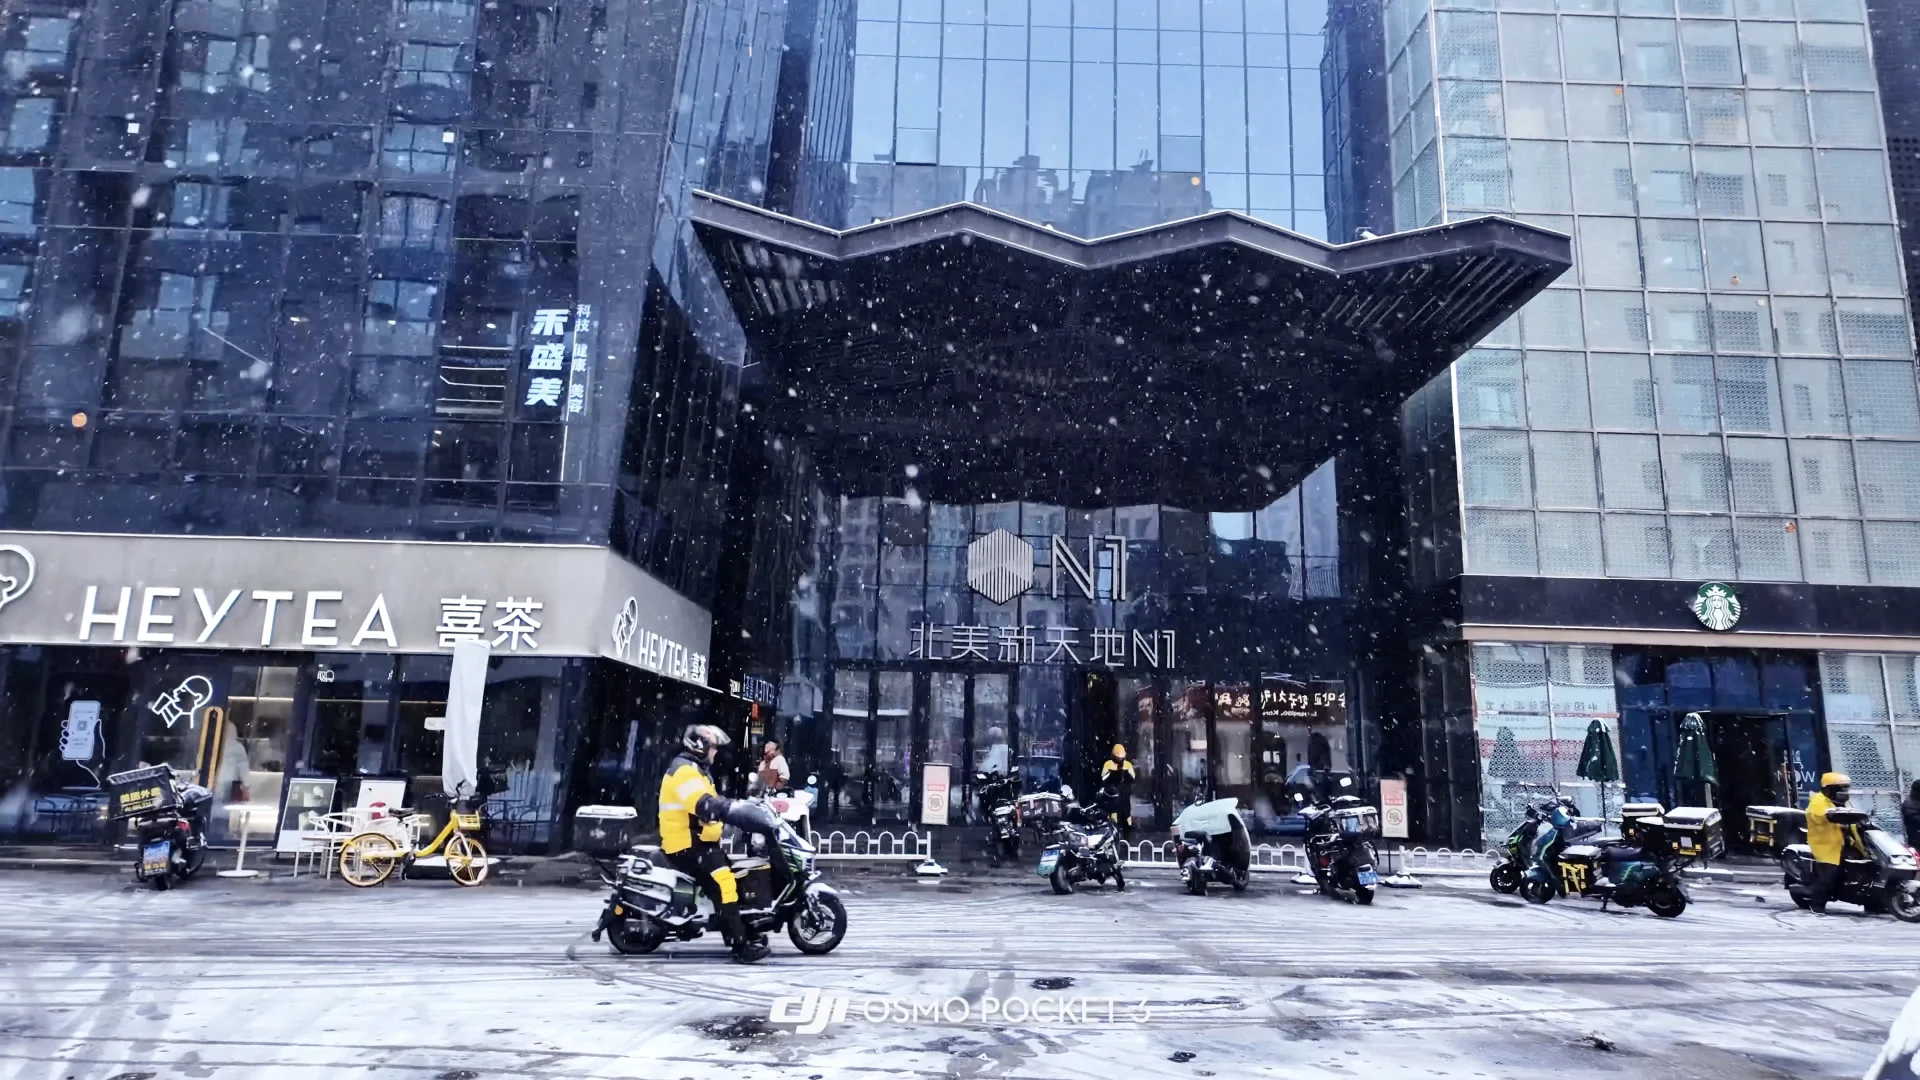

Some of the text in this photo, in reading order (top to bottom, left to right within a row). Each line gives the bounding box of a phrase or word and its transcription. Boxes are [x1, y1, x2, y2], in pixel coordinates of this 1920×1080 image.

[575, 304, 591, 332] 科技
[524, 308, 571, 406] 禾盛美
[1052, 533, 1126, 600] N1
[79, 585, 398, 647] HEYTEA
[436, 594, 543, 651] 喜茶
[639, 628, 689, 679] HEYTEA
[908, 622, 1175, 668] 北美新天地N1
